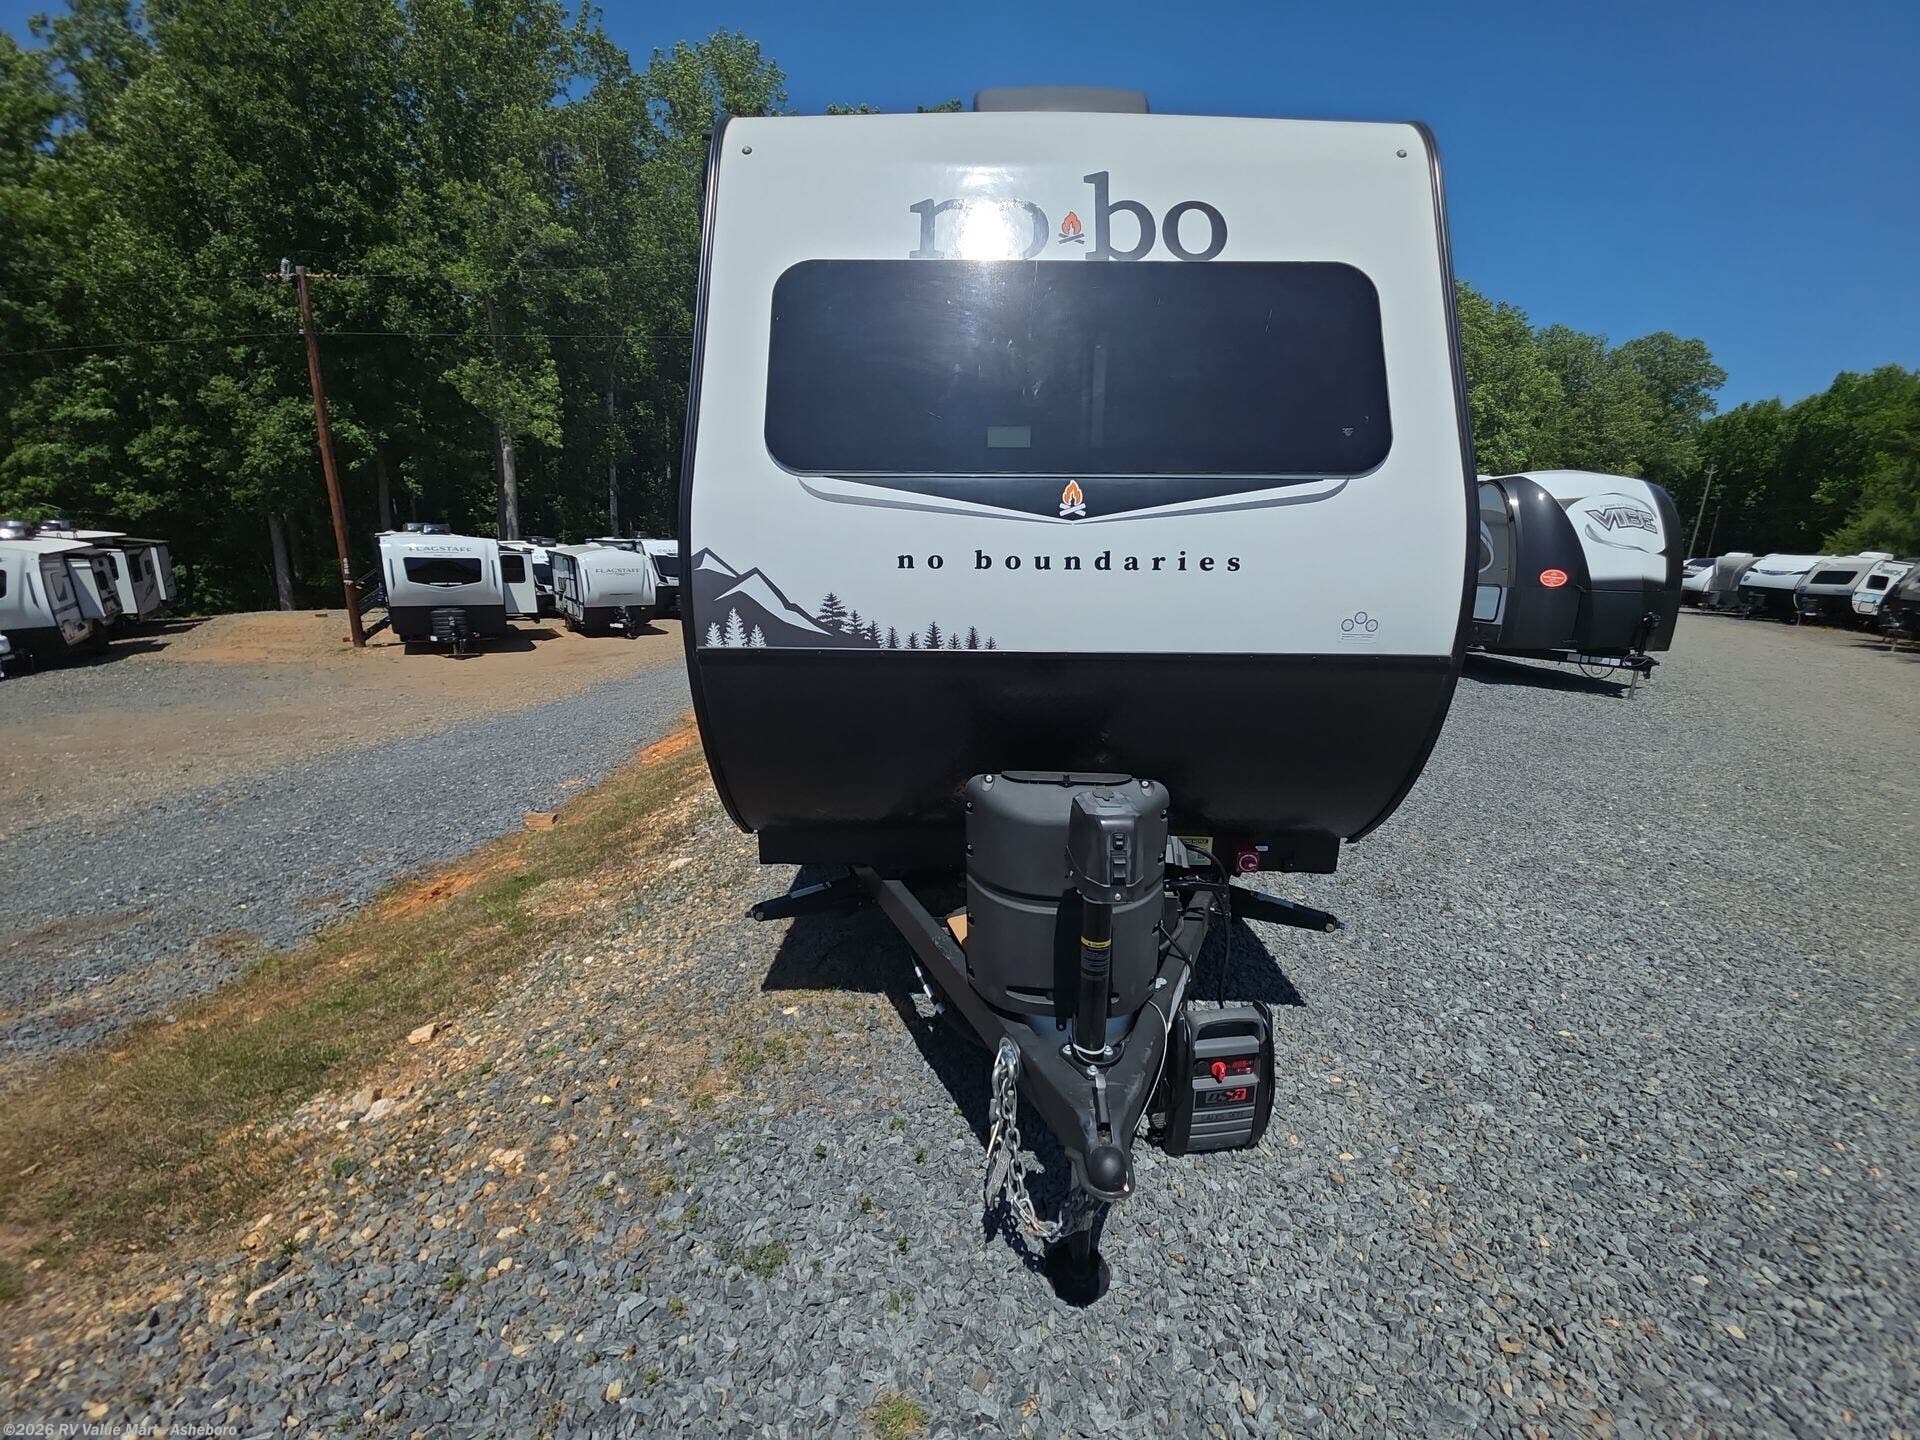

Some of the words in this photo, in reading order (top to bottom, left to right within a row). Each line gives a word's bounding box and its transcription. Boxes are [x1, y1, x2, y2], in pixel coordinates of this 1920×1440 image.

[1584, 507, 1658, 534] VIBE
[897, 552, 945, 570] no
[974, 550, 1242, 572] boundaries
